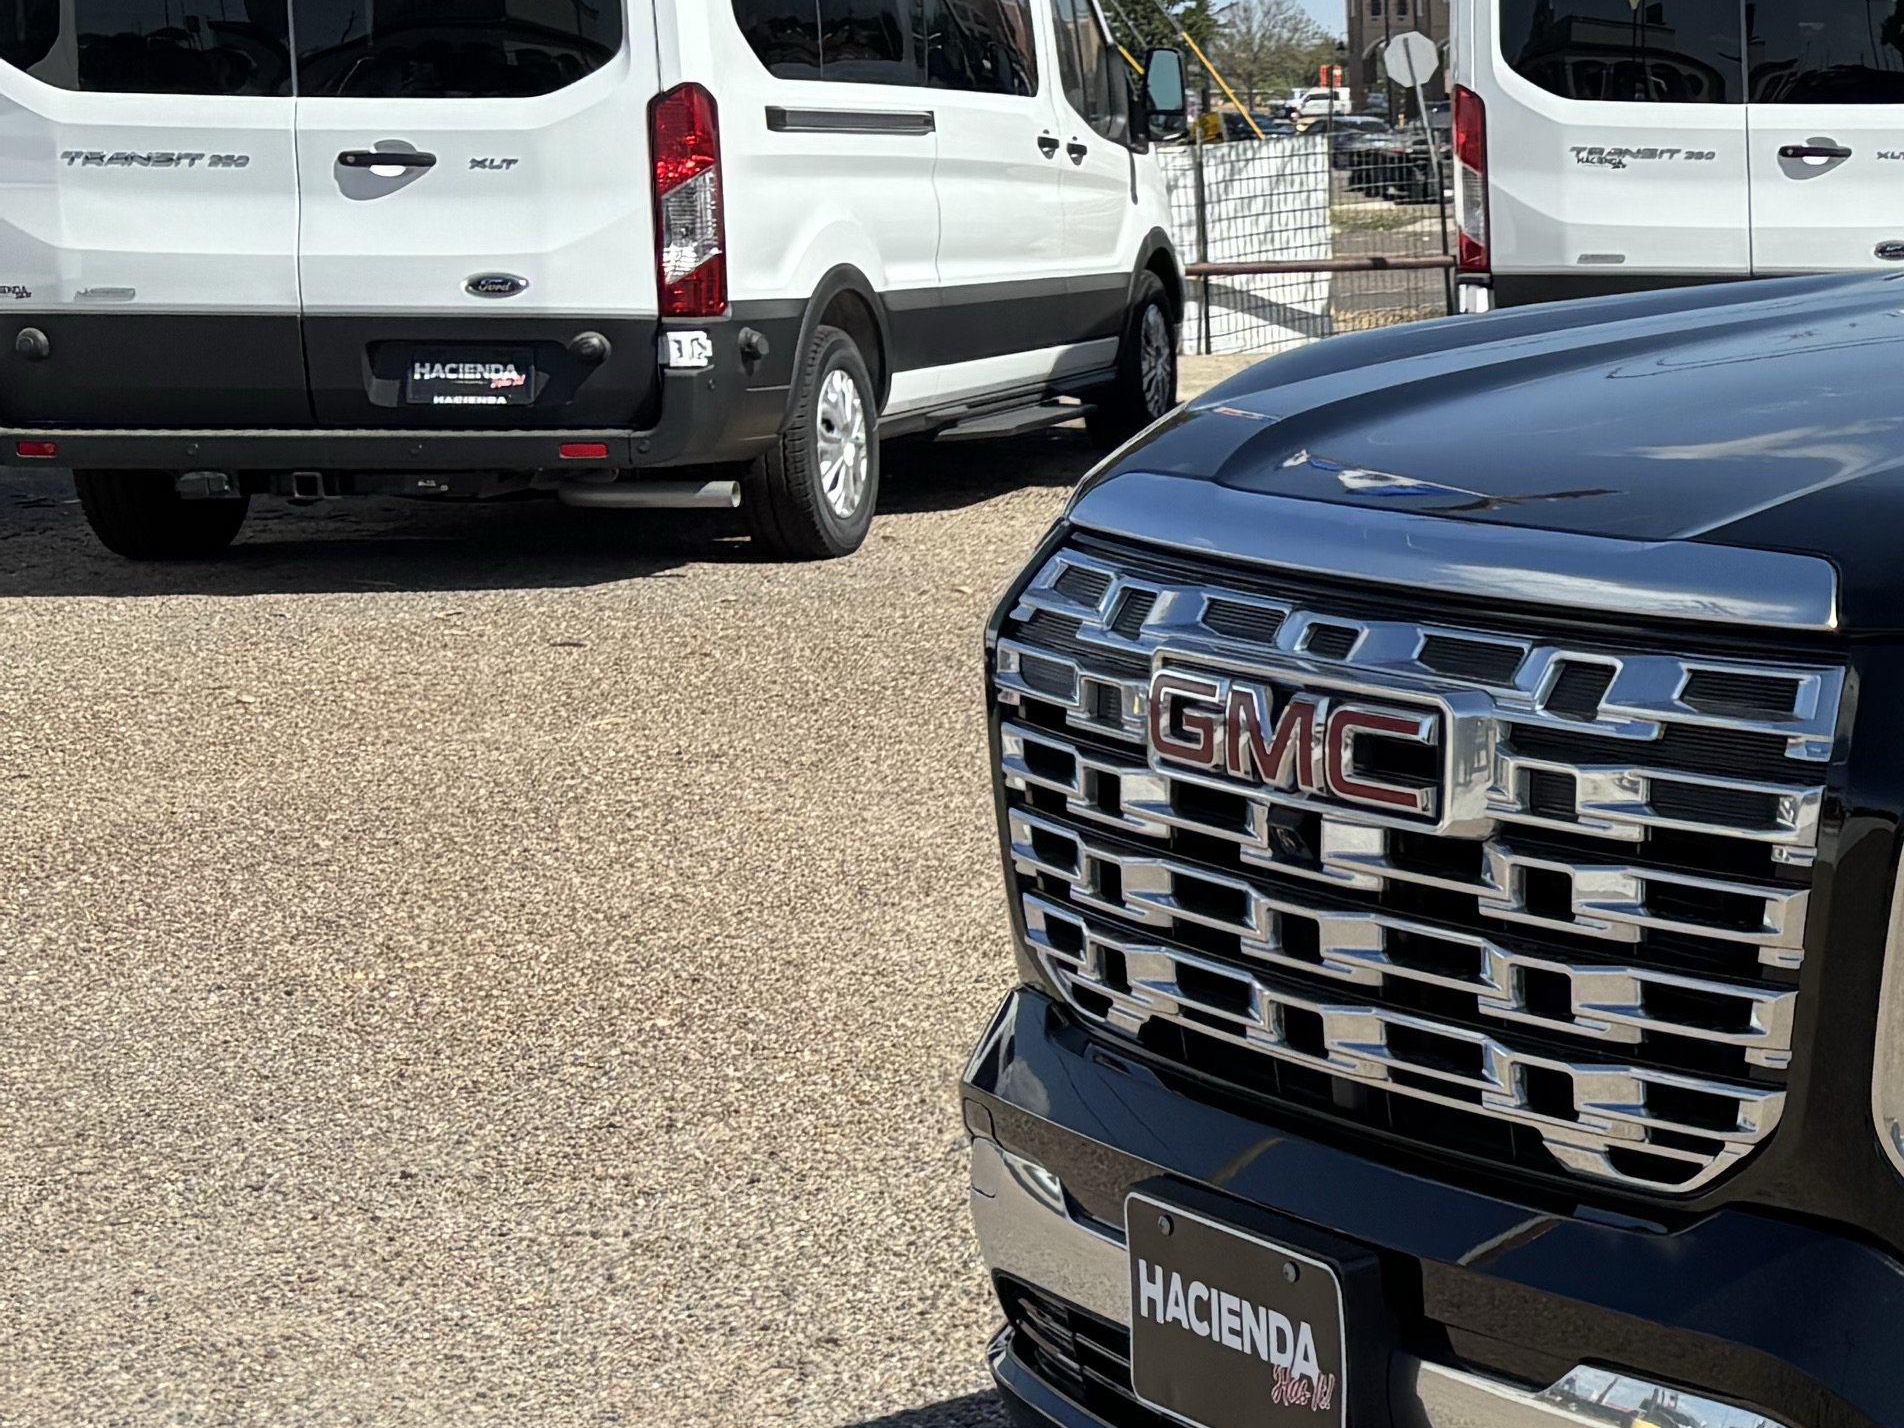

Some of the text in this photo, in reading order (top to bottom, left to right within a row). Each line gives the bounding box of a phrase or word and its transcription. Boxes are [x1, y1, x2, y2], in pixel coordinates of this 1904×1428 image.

[60, 150, 206, 168] TRANSIT
[1569, 146, 1682, 160] TRANSIT
[468, 157, 519, 171] XLT
[478, 278, 511, 291] Ford
[414, 362, 518, 380] HACIENDA
[1149, 668, 1440, 818] GMC
[1138, 1258, 1321, 1385] HACIENDA
